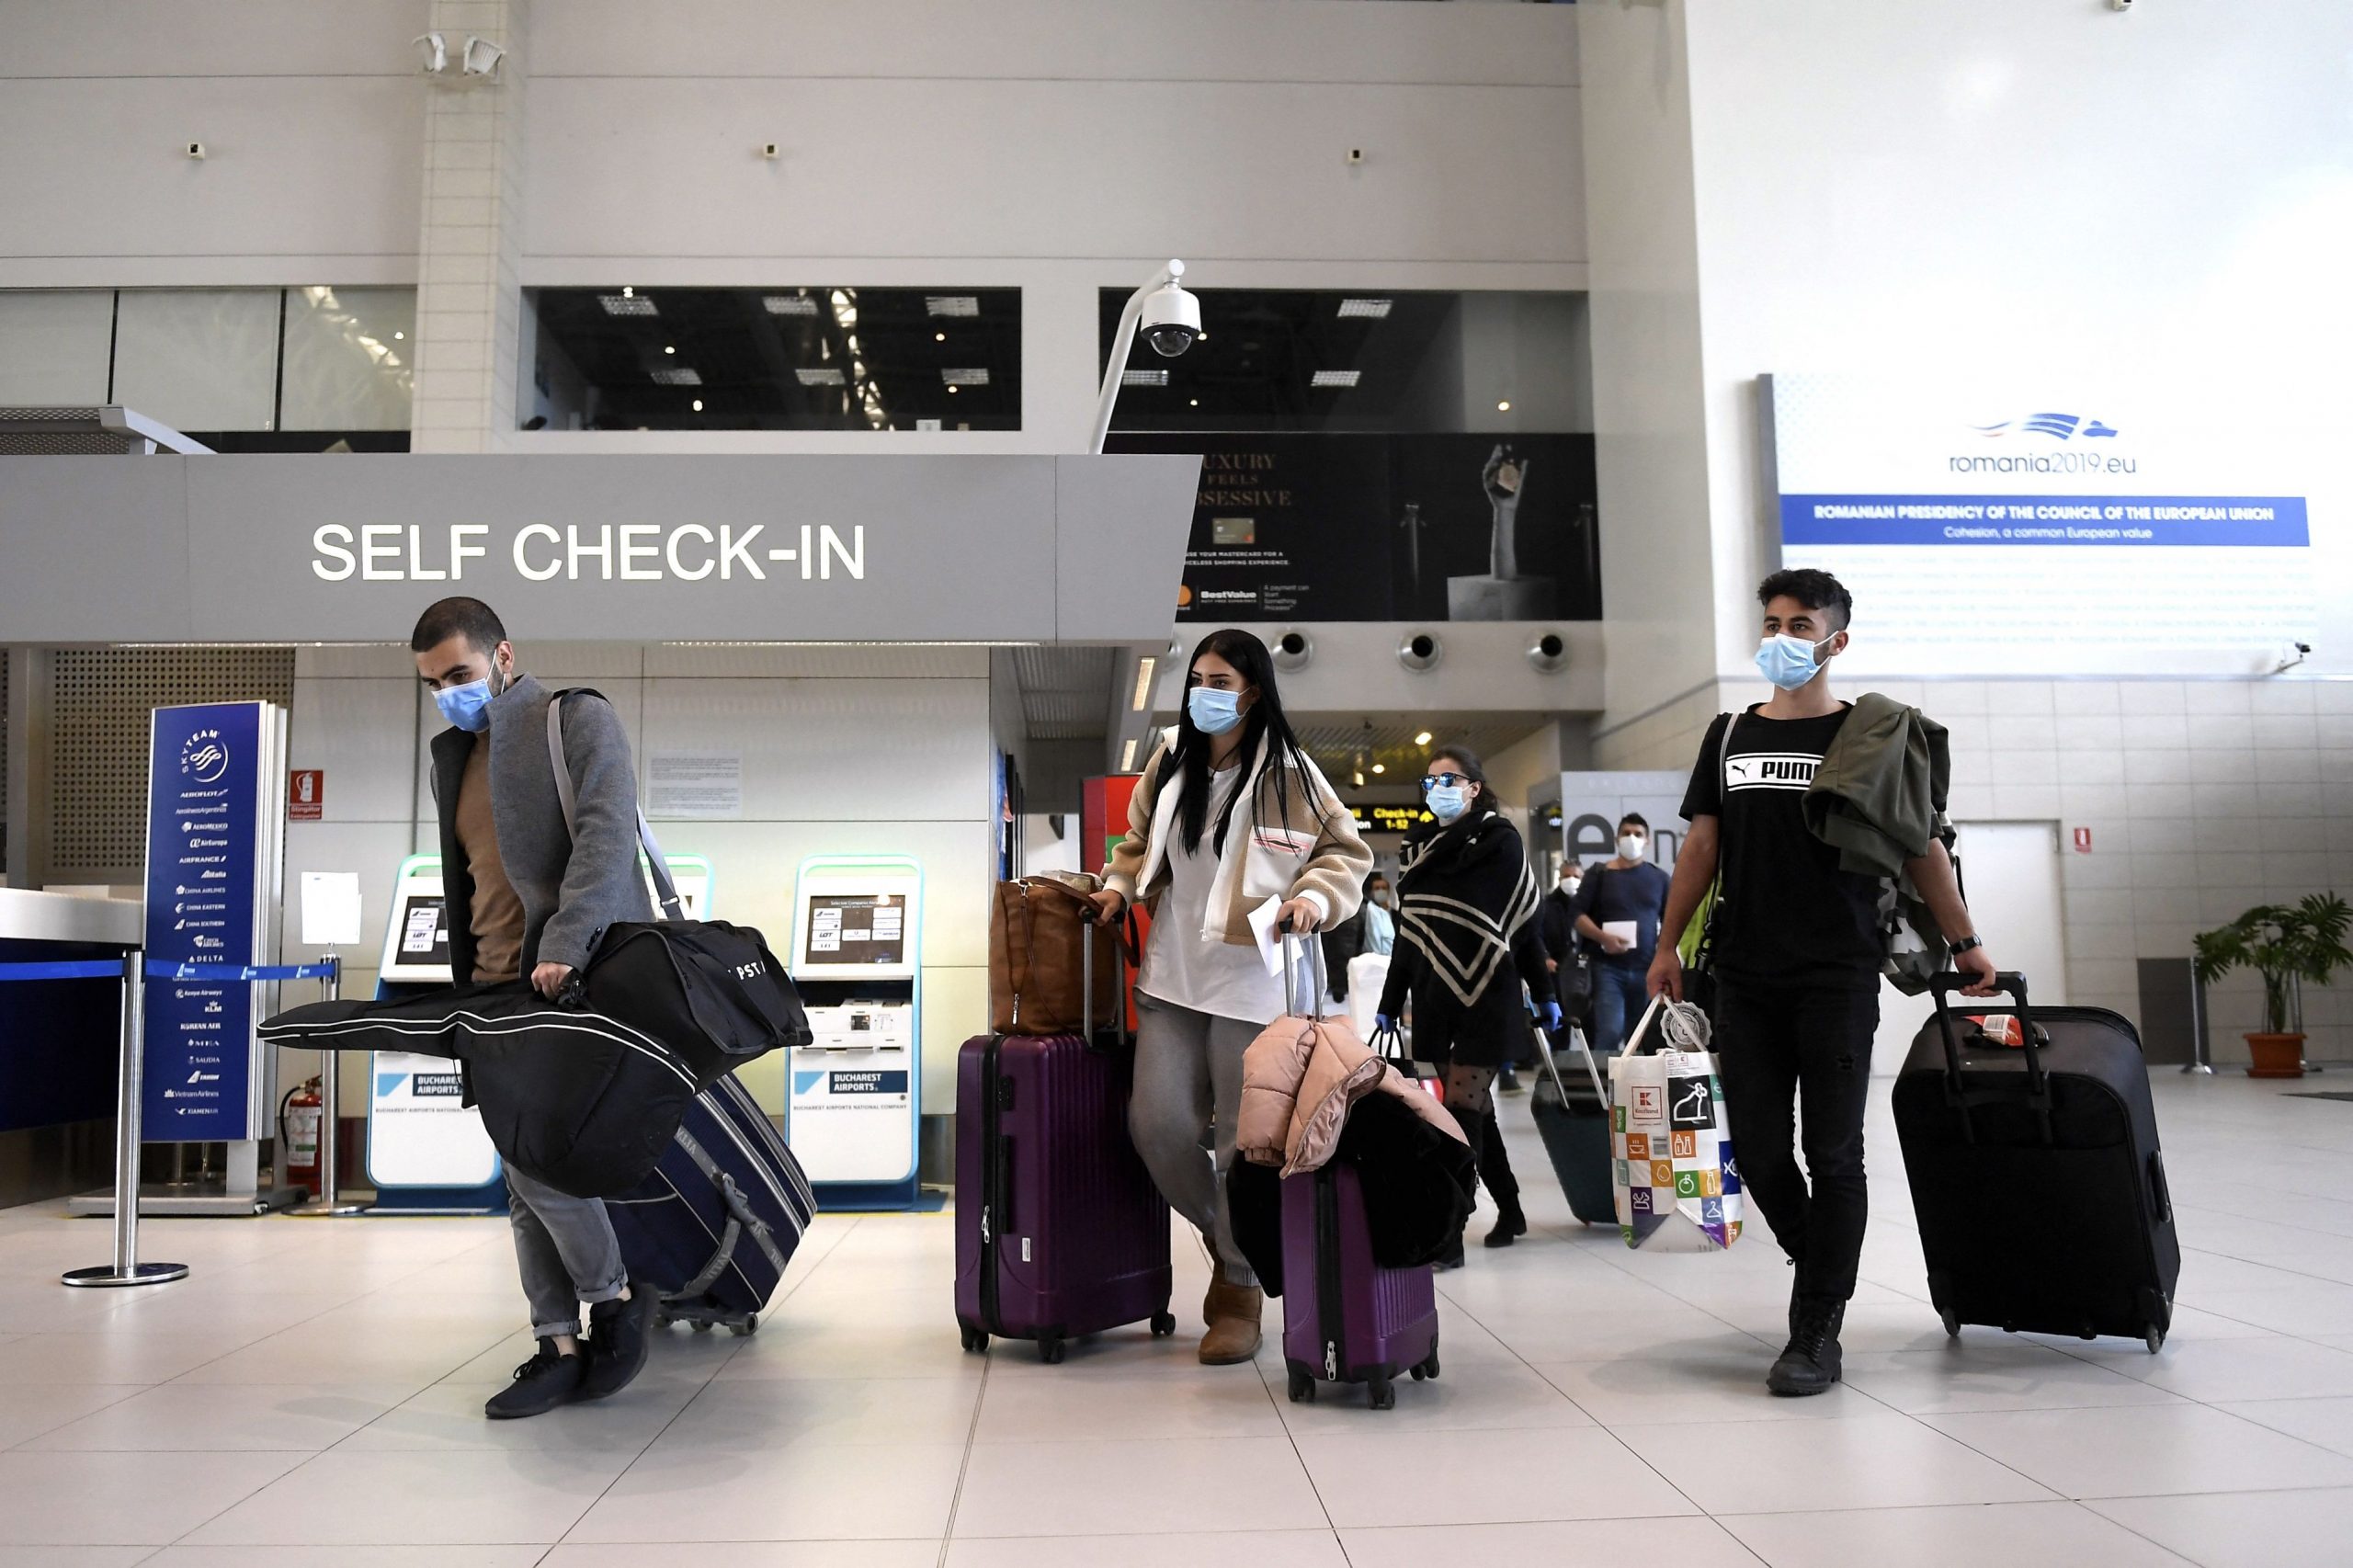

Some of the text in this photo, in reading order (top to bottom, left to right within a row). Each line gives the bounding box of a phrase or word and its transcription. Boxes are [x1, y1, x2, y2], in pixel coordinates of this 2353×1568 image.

[1203, 454, 1277, 469] UXURY
[1949, 452, 2136, 473] romania2019.eu
[1208, 474, 1258, 484] FEELS
[1813, 505, 2274, 521] ROMANIAN PRESIDENCY OF THE COUNCIL OF THE EUROPEAN UNION
[1943, 526, 2153, 540] Cohesion, a common European value
[312, 523, 865, 581] SELF CHECK-IN
[180, 729, 219, 774] SKYTEAM
[1373, 808, 1418, 818] Check-in
[180, 1022, 207, 1030] KOREAN
[417, 1075, 462, 1085] BUCHARE
[834, 1074, 882, 1082] BUCHAREST
[417, 1085, 458, 1094] AIRPORTS
[834, 1083, 875, 1091] AIRPORTS
